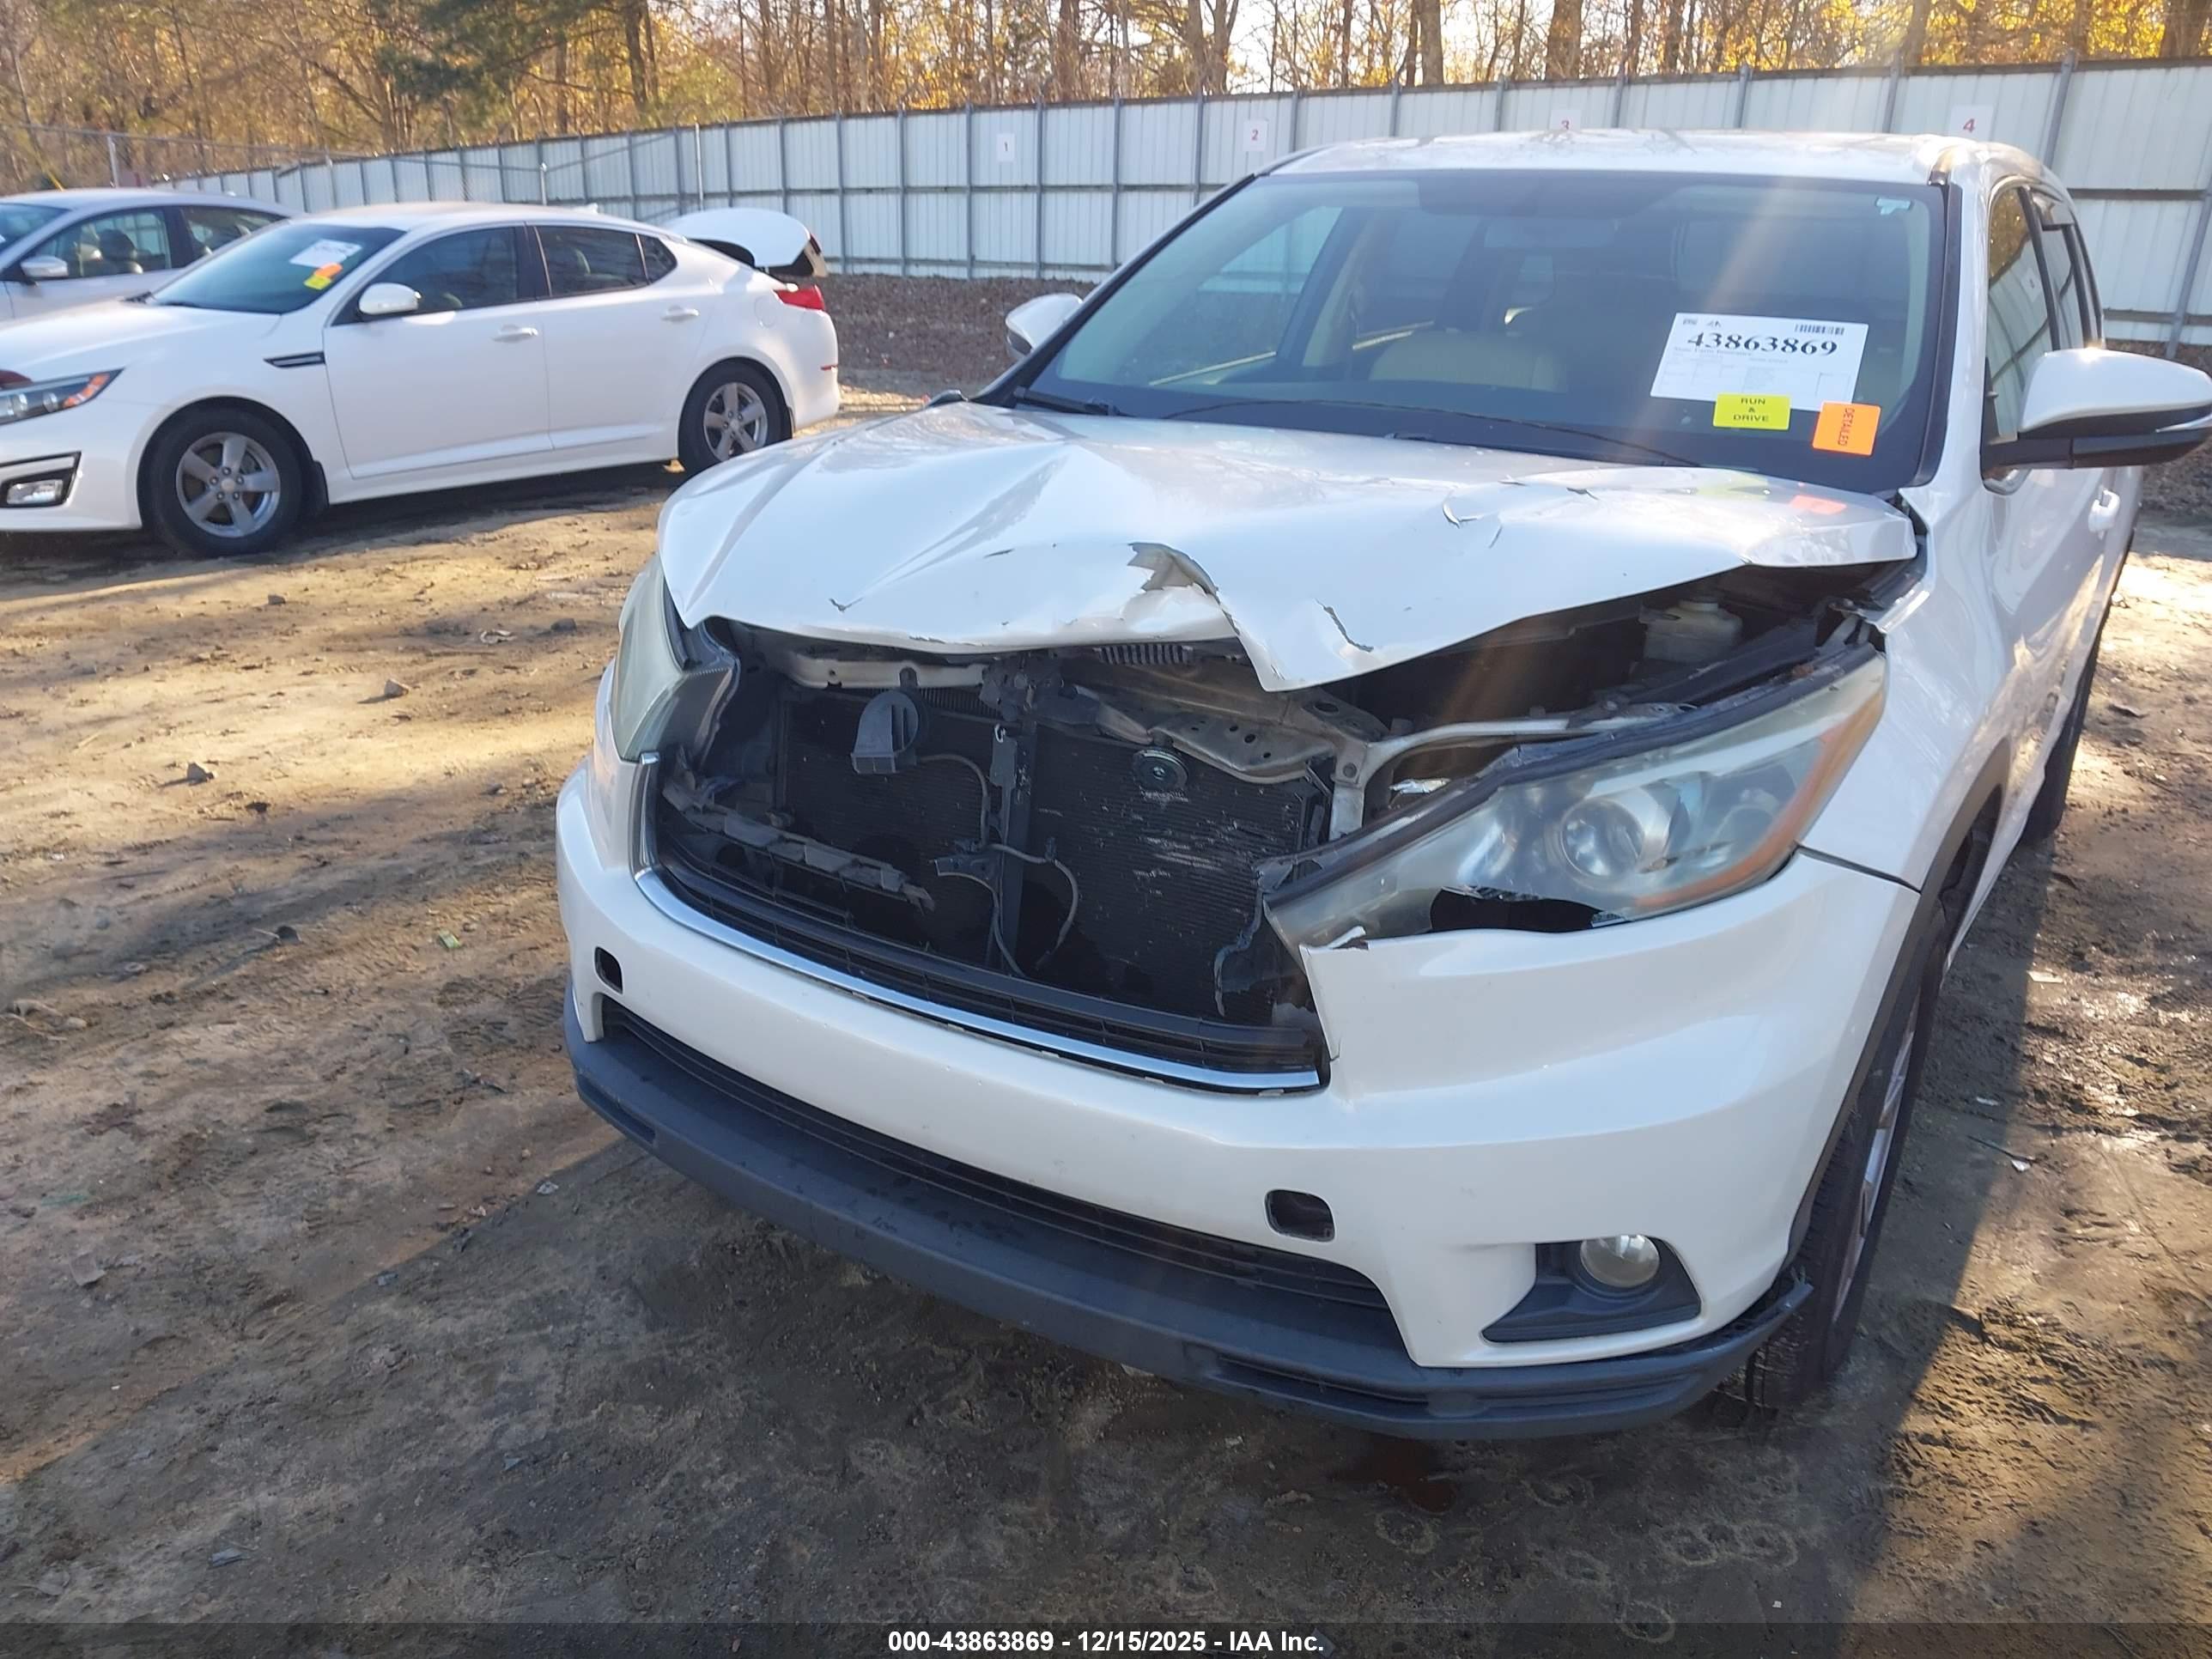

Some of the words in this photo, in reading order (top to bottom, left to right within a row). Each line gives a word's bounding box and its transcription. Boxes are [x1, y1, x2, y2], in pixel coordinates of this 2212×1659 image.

[1963, 118, 1975, 133] 4
[1251, 130, 1259, 141] 2
[1004, 142, 1008, 152] 1
[1687, 331, 1838, 356] 43863869
[1733, 414, 1769, 422] DRIVE
